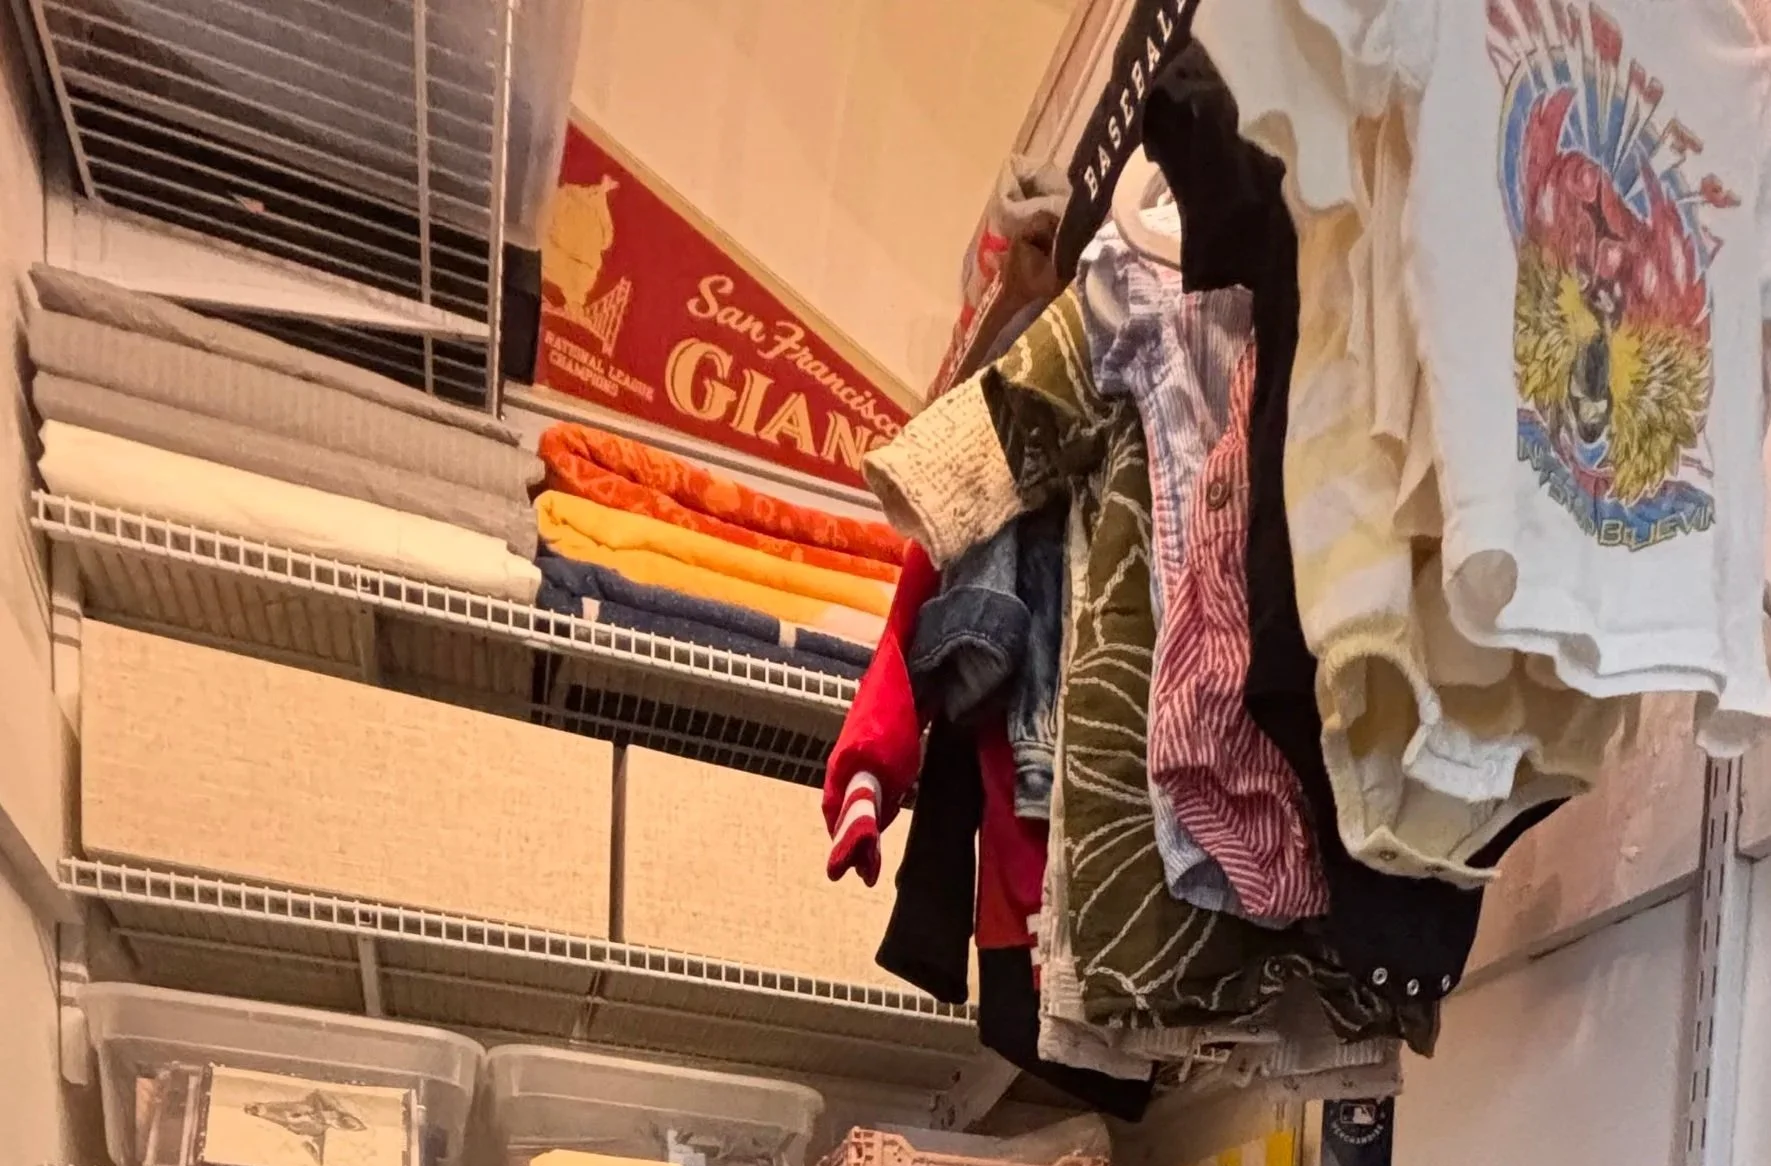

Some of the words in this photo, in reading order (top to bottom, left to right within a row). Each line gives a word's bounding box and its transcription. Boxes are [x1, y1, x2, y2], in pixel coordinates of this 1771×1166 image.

[549, 348, 620, 398] CHAMPIONS
[607, 365, 655, 404] LEAGUE
[686, 274, 766, 344] San
[757, 319, 900, 438] Francisco
[664, 337, 893, 472] GIAN
